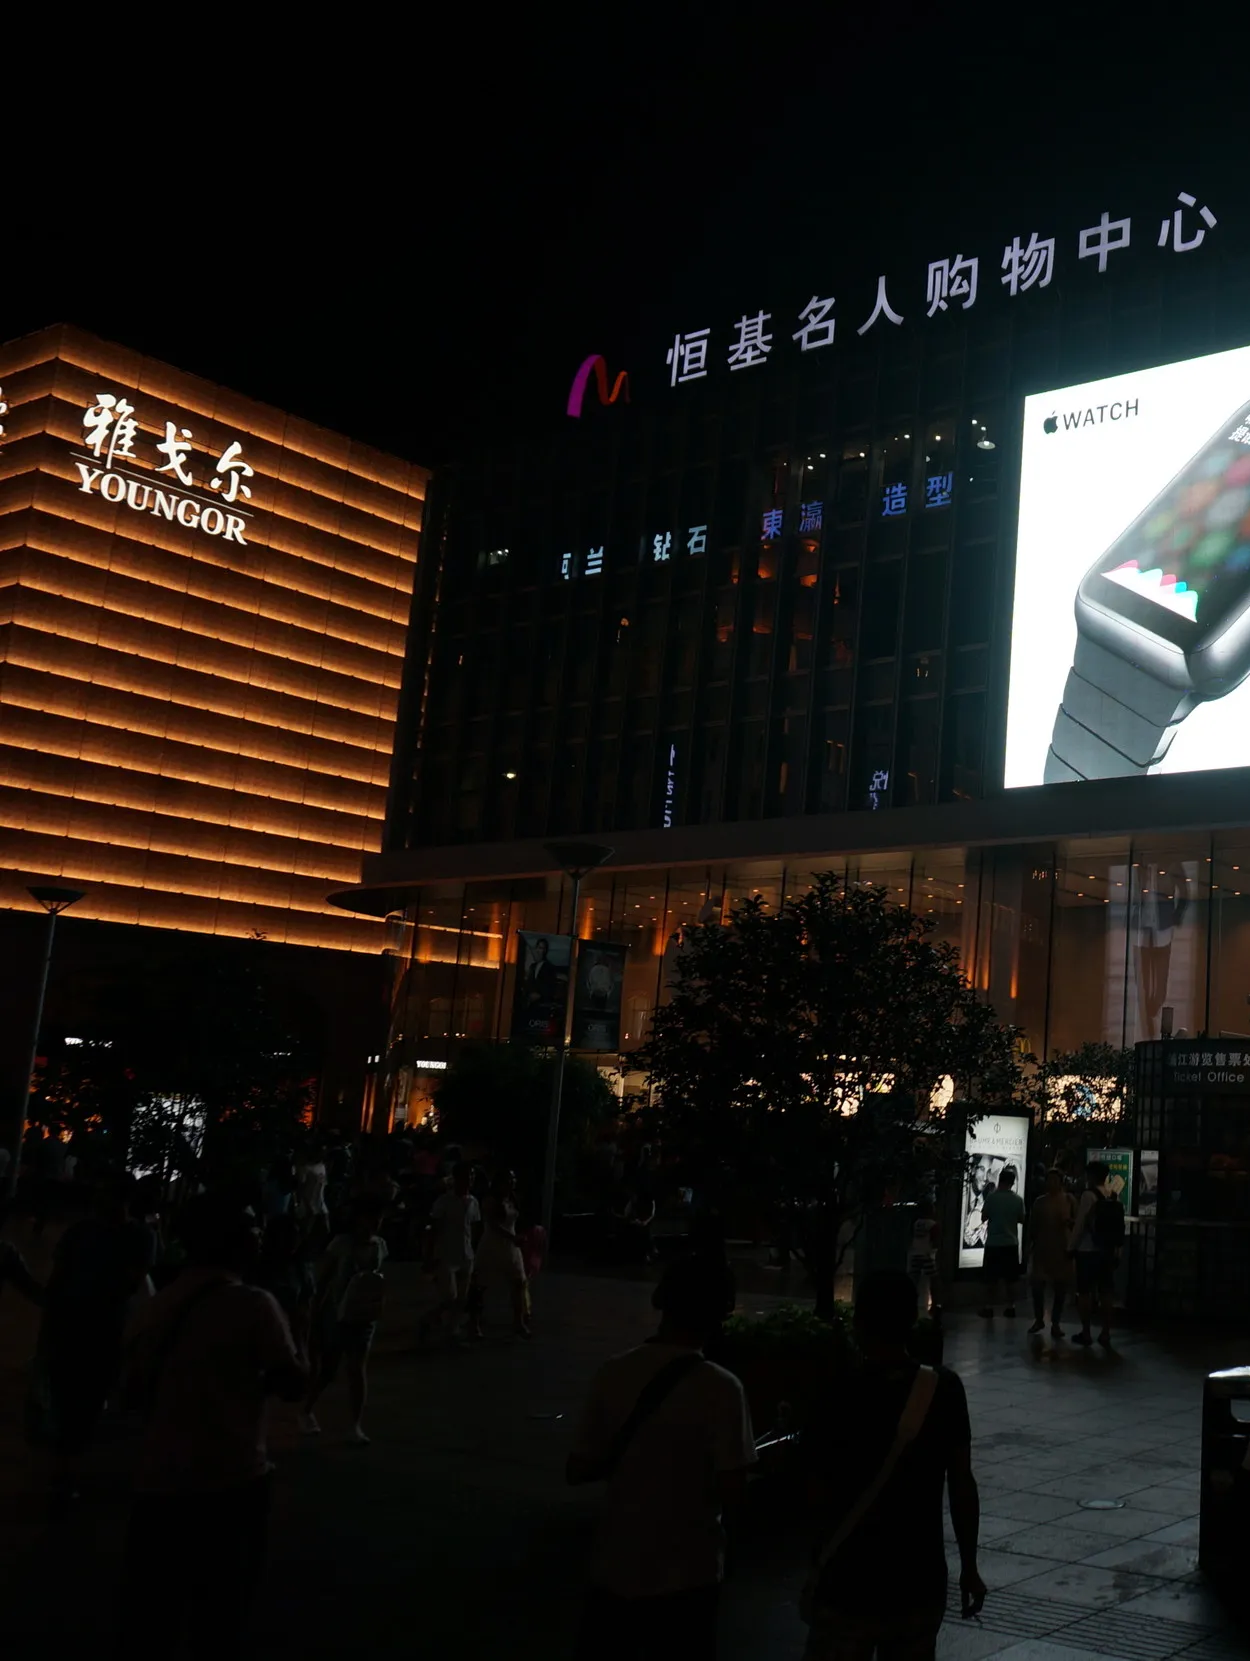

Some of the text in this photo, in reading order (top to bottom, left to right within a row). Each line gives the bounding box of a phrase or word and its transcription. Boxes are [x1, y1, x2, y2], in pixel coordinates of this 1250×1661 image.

[666, 191, 1218, 387] 恒基名人购物中心
[83, 393, 255, 503] 雅戈尔
[1063, 398, 1139, 430] WATCH
[75, 462, 248, 546] YOUNGOR
[1173, 1071, 1245, 1083] Ticket Office
